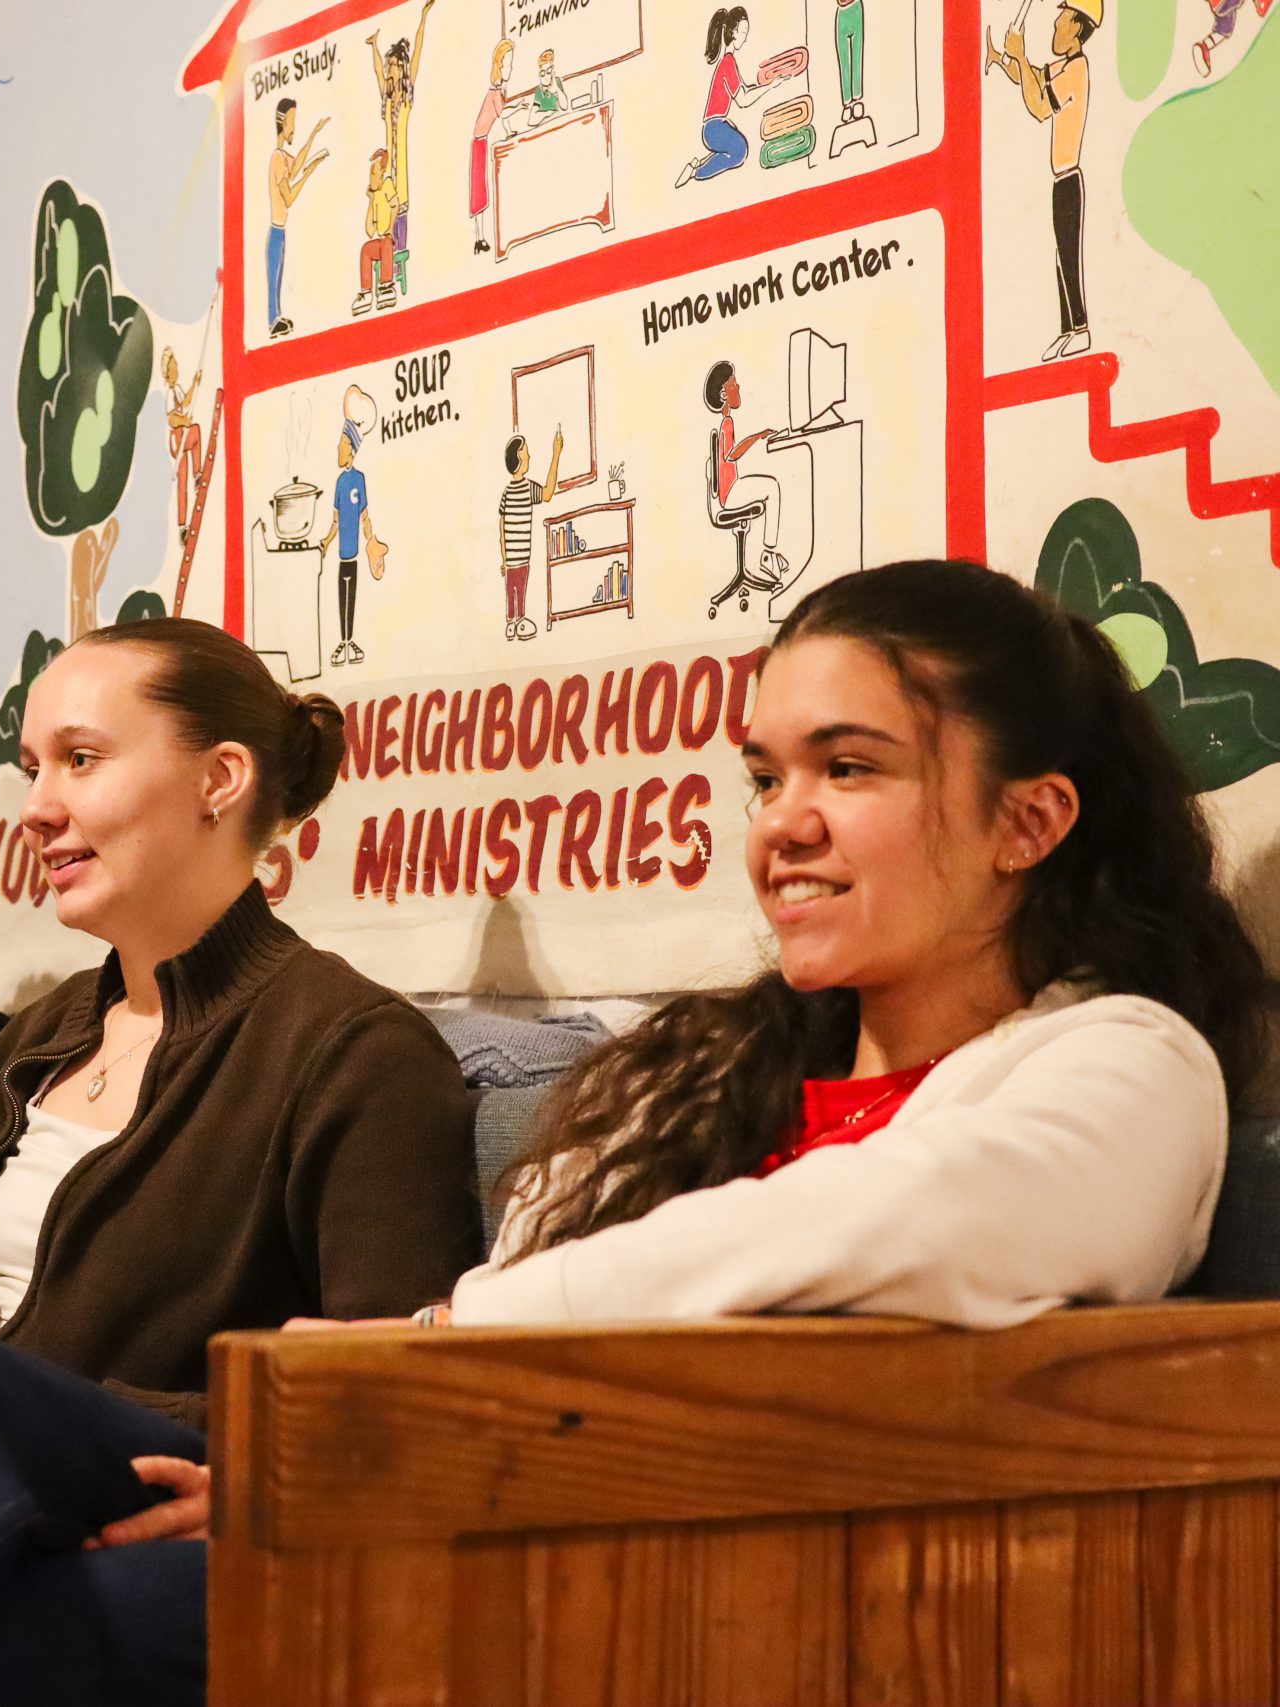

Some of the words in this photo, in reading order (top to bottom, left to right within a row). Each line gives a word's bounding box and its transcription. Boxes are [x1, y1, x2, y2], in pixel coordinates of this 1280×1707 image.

[251, 60, 290, 101] Bible
[293, 40, 341, 82] Study.
[792, 238, 914, 296] Center.
[395, 349, 451, 402] SOUP
[381, 399, 460, 444] kitchen.
[352, 773, 713, 906] MINISTRIES
